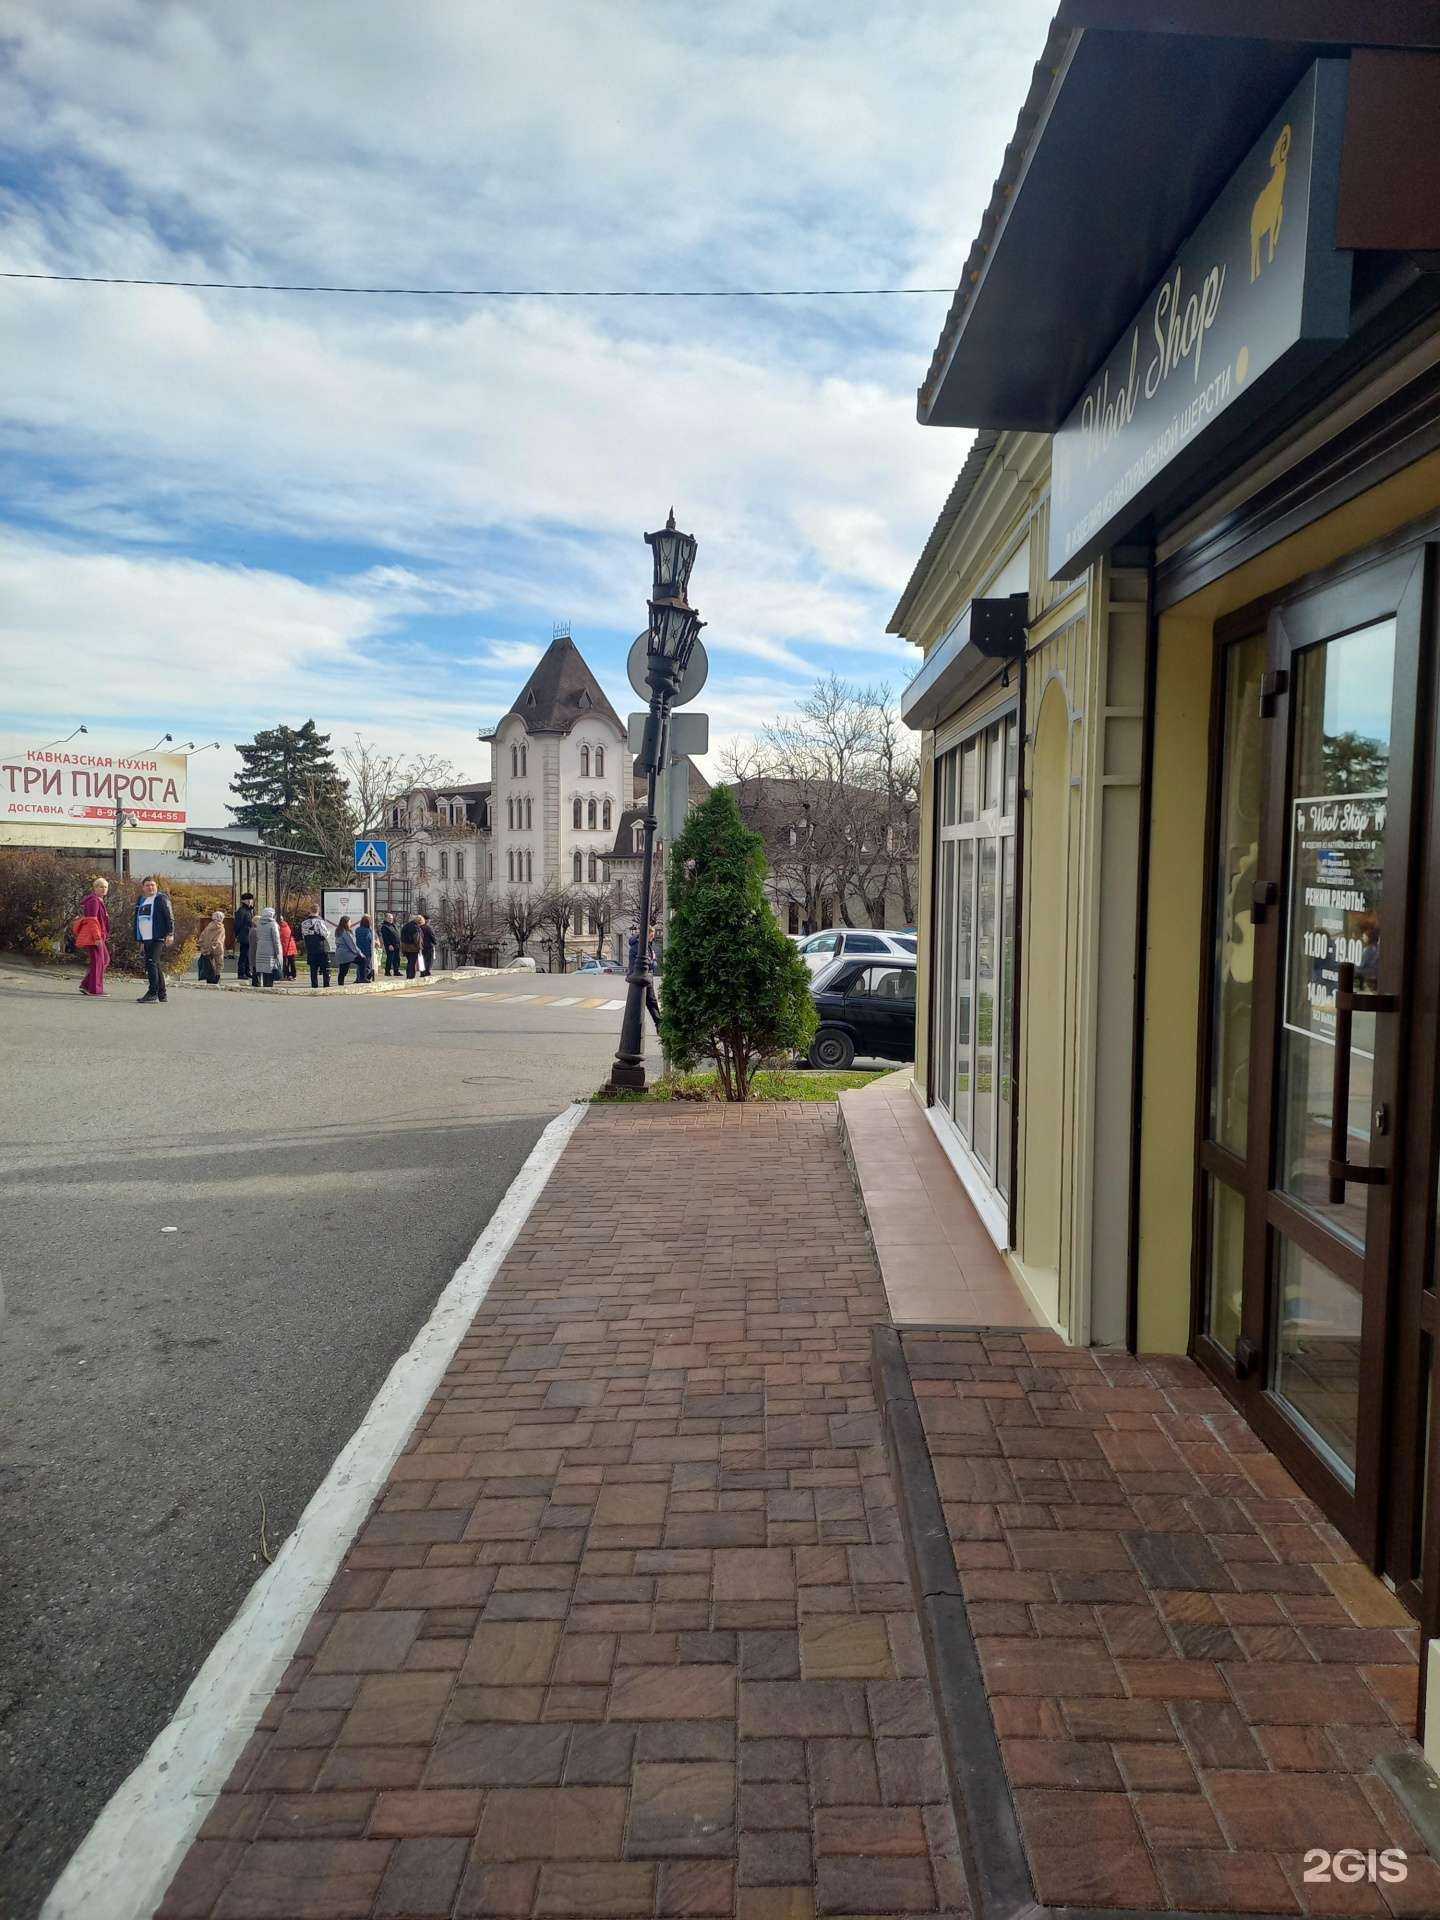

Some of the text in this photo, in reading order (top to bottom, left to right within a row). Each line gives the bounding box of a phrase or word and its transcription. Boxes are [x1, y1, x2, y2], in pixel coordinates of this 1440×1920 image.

[1081, 263, 1227, 468] Wool Shop
[1113, 414, 1179, 503] НАТУРАЛЬНОЙ
[1180, 363, 1231, 440] ШЕРСТИ
[27, 750, 157, 771] КАВКАЗСКАЯ КУХНЯ
[2, 765, 179, 803] ТРИ ПИРОГА
[7, 803, 64, 815] ДОСТАВКА
[1310, 803, 1369, 840] Wool Shop
[1305, 887, 1366, 912] РЕЖИМ РАБОТЫ:
[1304, 931, 1327, 959] 11.00
[1334, 936, 1362, 966] 19.00
